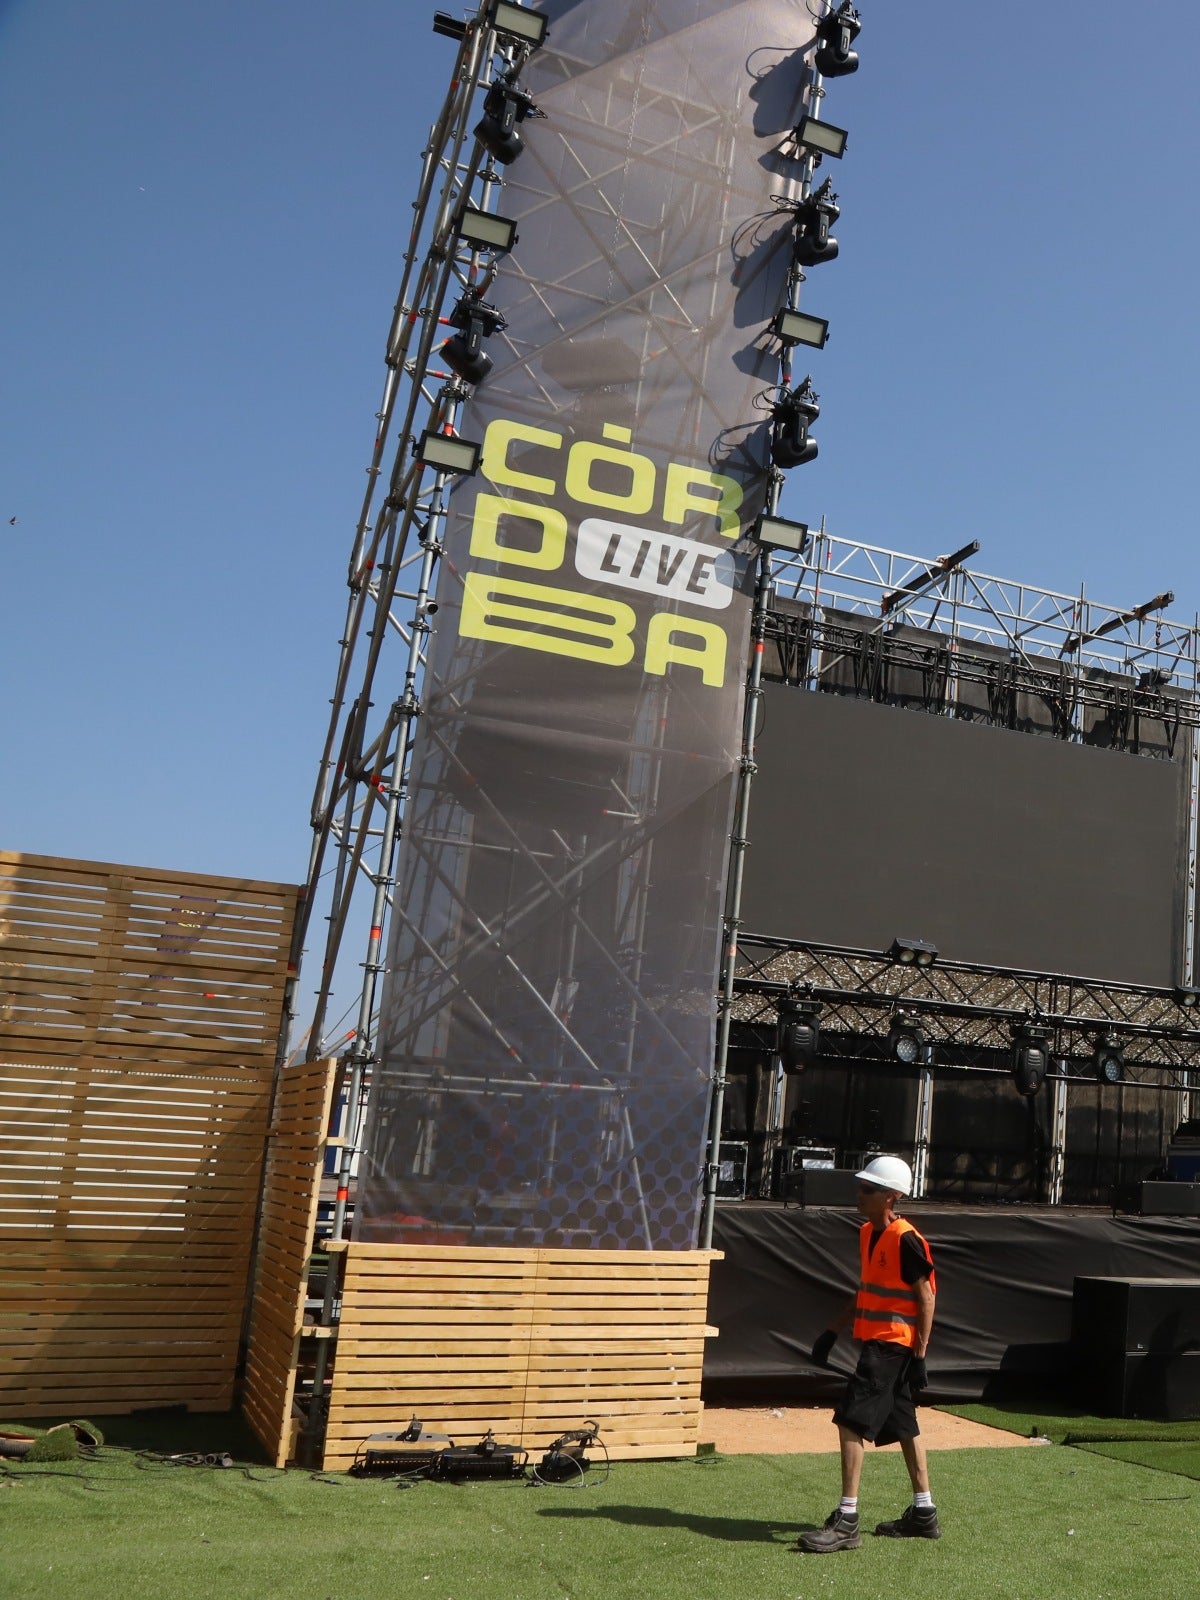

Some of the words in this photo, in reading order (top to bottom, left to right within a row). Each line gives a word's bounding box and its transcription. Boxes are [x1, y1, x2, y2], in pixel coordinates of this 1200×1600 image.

[469, 492, 568, 571] D
[599, 532, 717, 597] LIVE
[458, 571, 728, 688] BA
